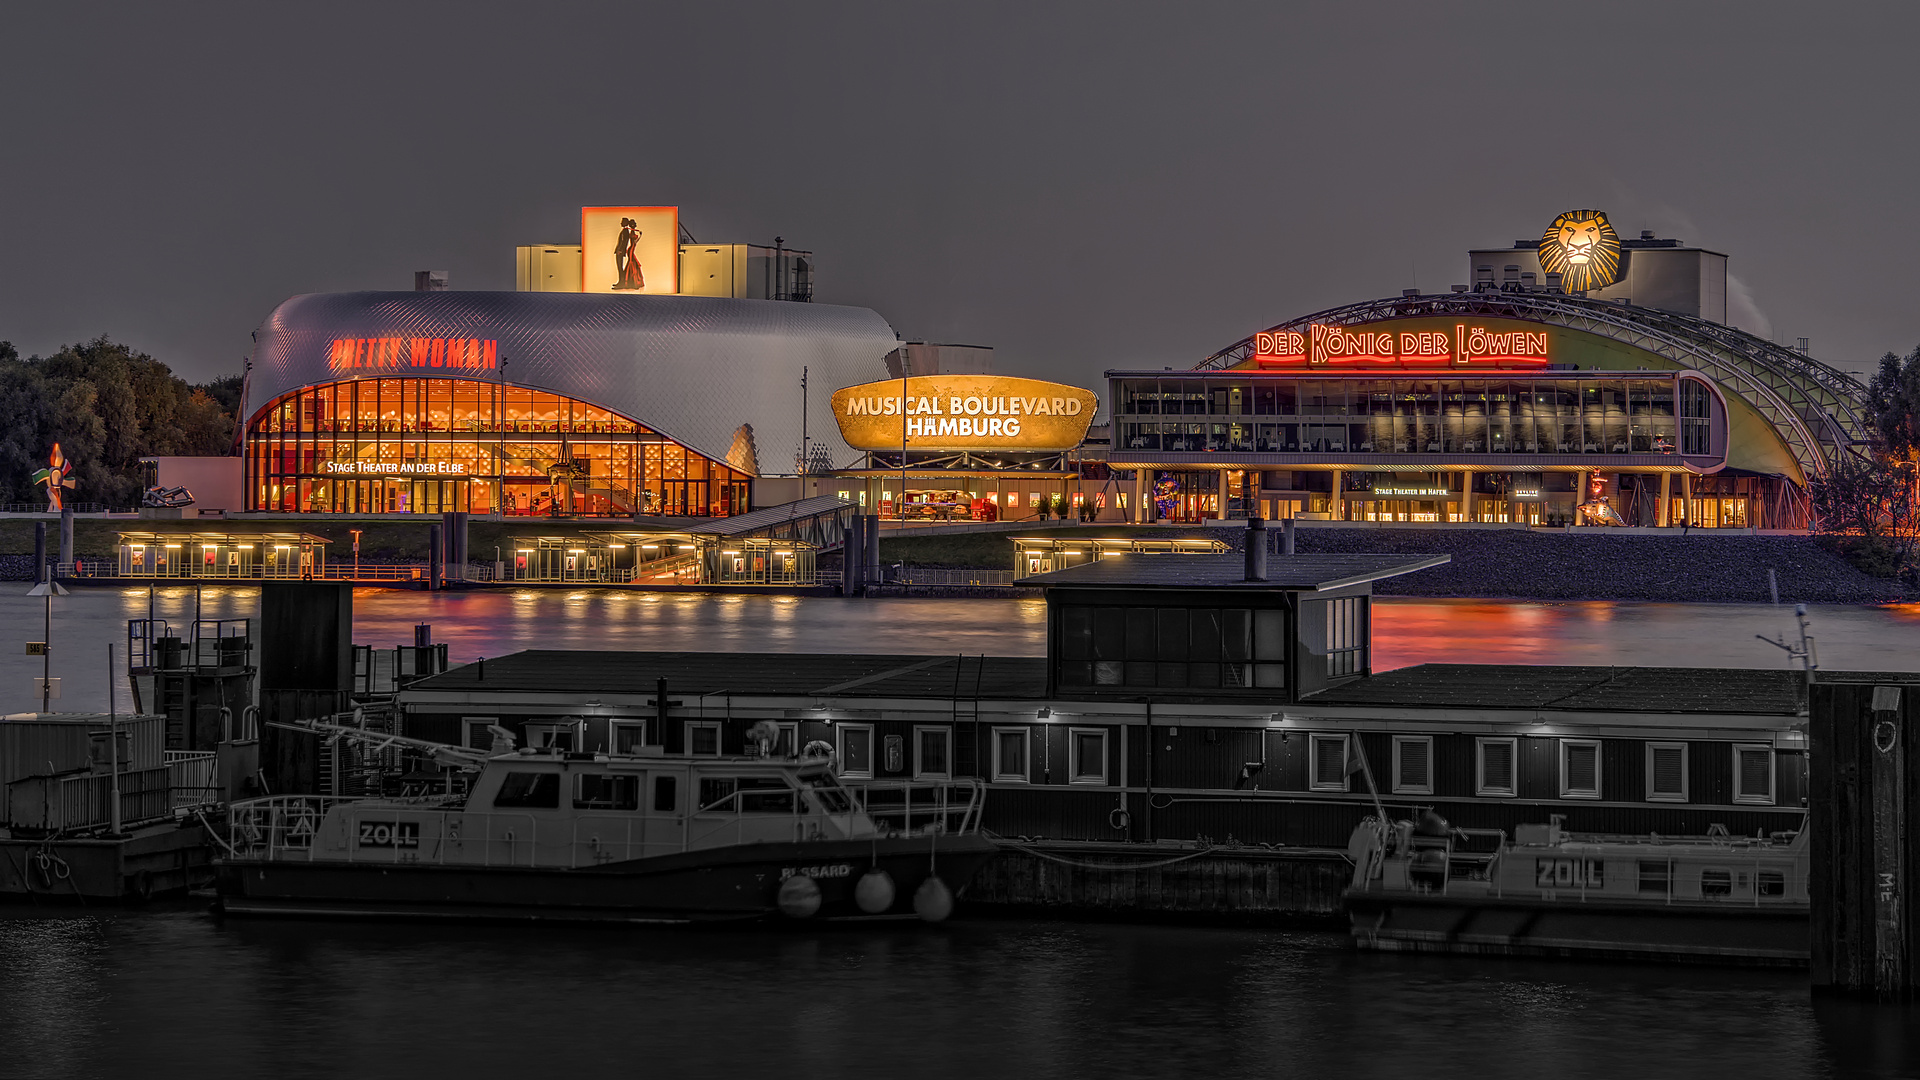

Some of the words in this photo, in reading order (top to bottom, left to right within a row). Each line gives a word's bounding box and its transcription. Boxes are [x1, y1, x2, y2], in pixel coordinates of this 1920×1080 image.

[329, 337, 402, 369] PRETTY
[411, 337, 498, 370] WOMAN
[1256, 332, 1305, 355] DER
[1311, 324, 1393, 363] KÖNIG
[1400, 332, 1449, 355] DER
[1456, 324, 1547, 363] LÖWEN
[846, 396, 942, 416] MUSICAL
[950, 396, 1081, 416] BOULEVARD
[907, 415, 1020, 437] HAMBURG
[326, 461, 355, 473] STAGE
[356, 461, 398, 473] THEATER
[400, 463, 415, 473] AN
[417, 463, 436, 473] DER
[438, 461, 463, 473] ELBE
[360, 823, 418, 846] ZOLL
[1539, 858, 1603, 888] ZOLL
